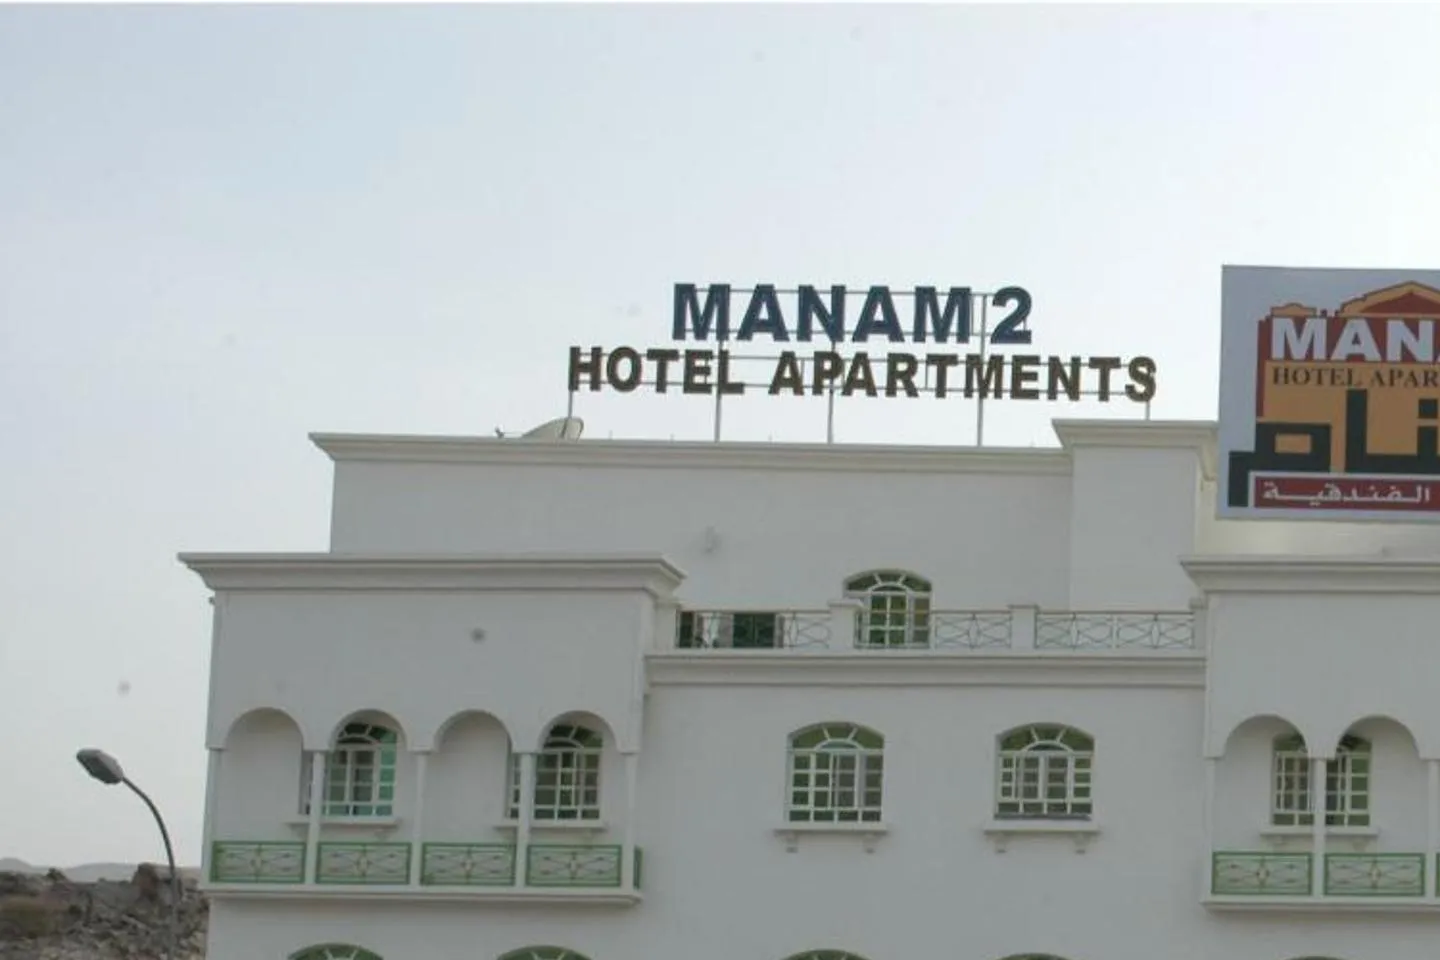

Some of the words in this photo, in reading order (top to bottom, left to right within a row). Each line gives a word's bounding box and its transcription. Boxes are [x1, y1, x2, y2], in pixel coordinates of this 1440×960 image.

[672, 283, 974, 344] MANAM
[990, 286, 1033, 344] 2
[568, 346, 745, 394] HOTEL
[768, 350, 1158, 403] APARTMENTS
[1272, 366, 1362, 387] HOTEL
[1263, 480, 1431, 507] الفندقية
